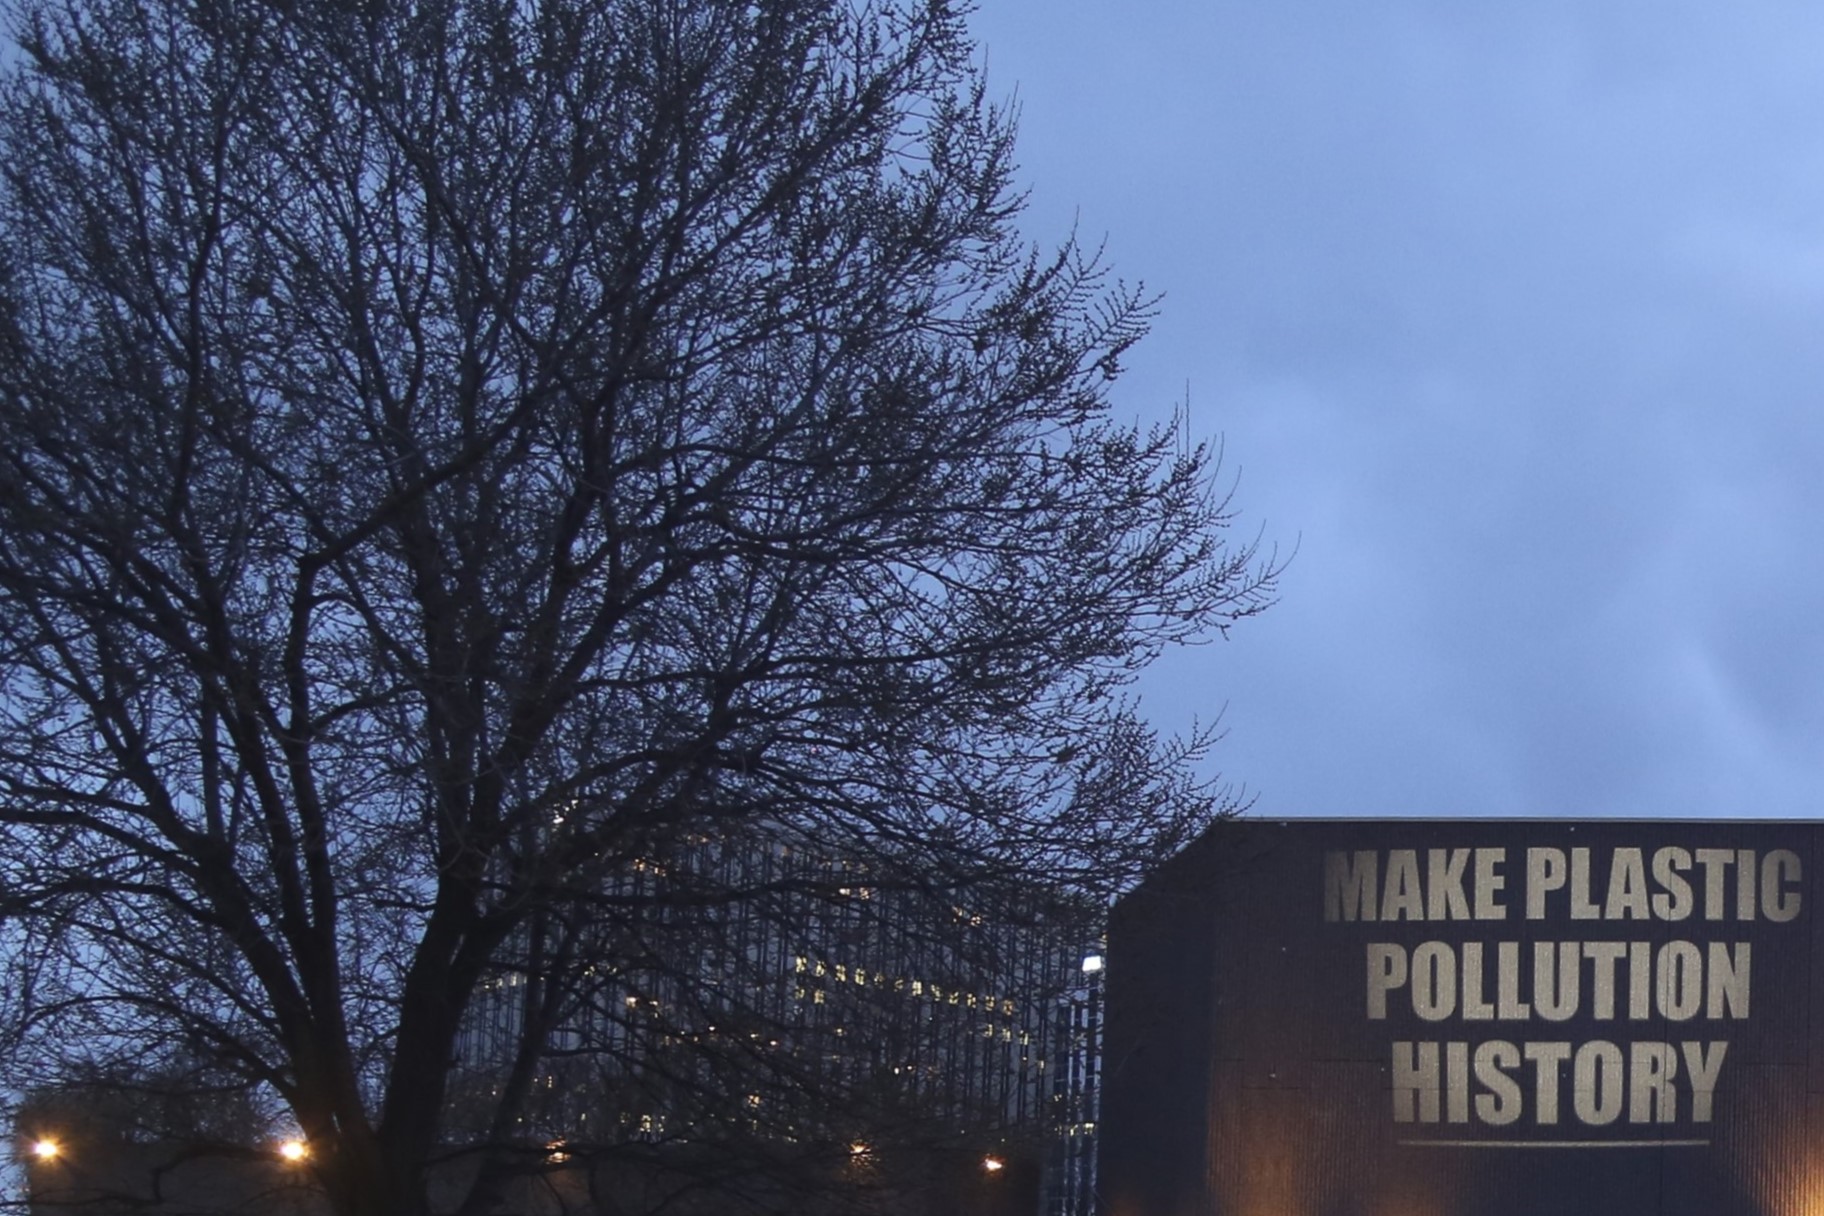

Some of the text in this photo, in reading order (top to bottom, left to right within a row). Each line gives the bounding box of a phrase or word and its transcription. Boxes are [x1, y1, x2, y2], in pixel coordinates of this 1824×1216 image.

[1324, 846, 1802, 923] MAKE PLASTIC
[1366, 940, 1751, 1022] POLLUTION
[1392, 1040, 1729, 1126] HISTORY
